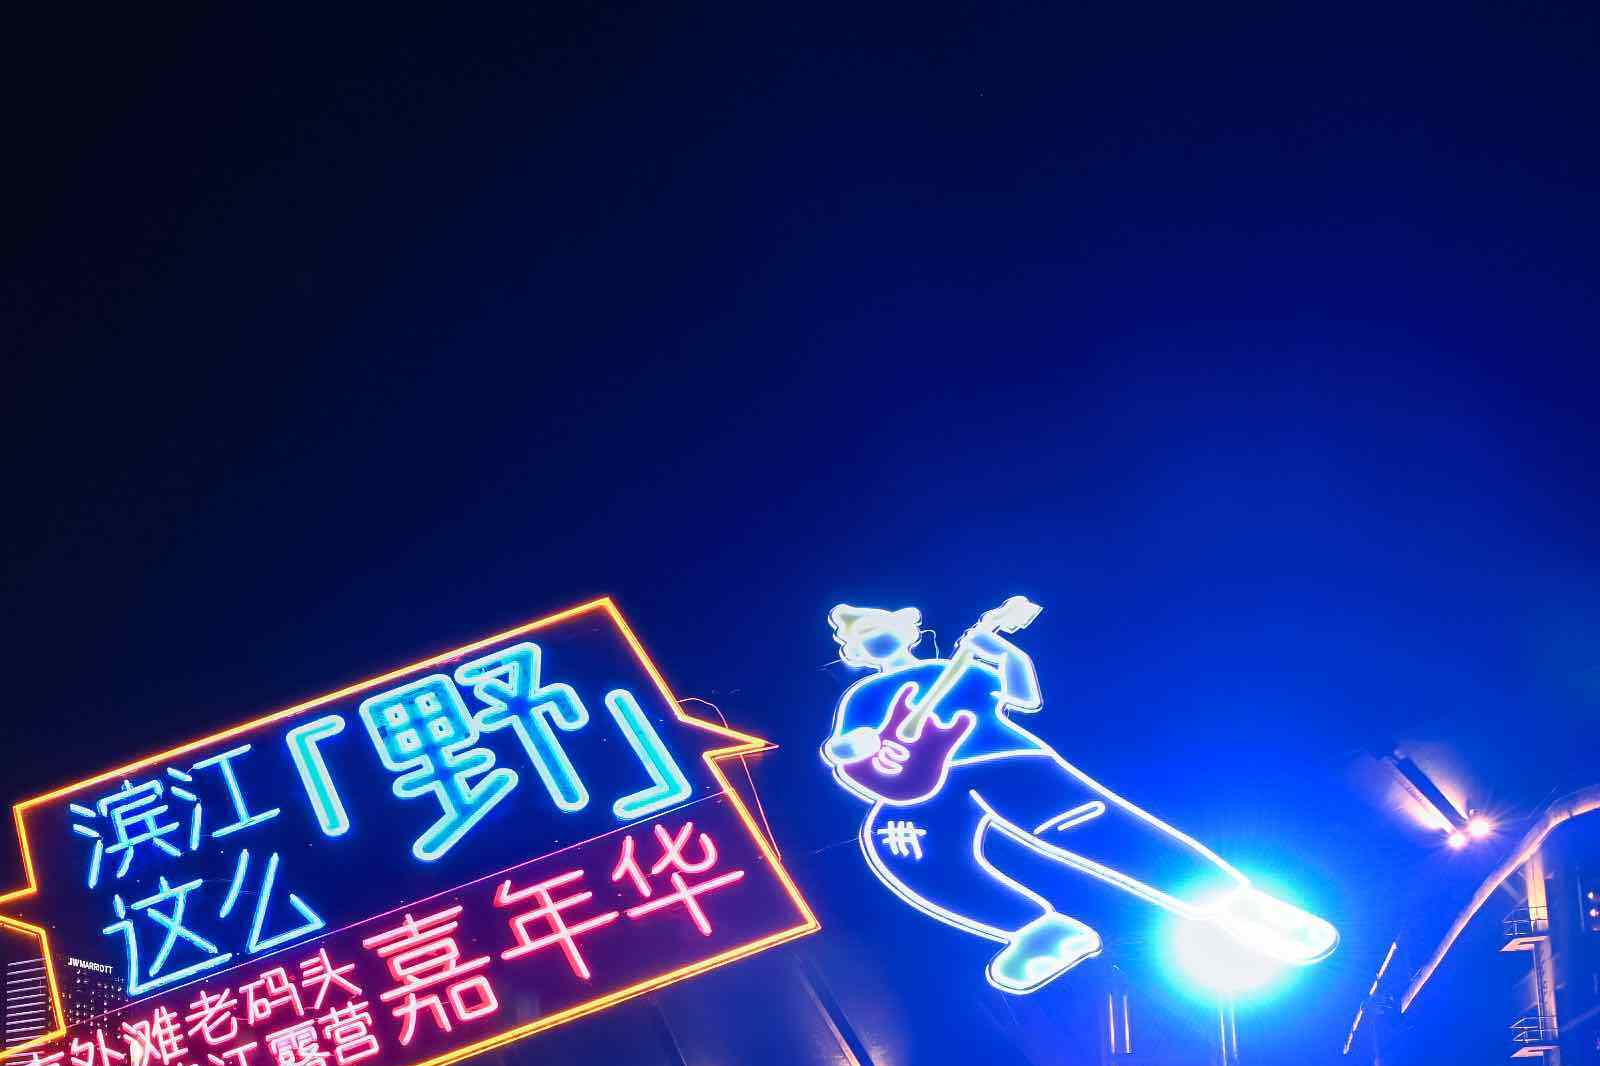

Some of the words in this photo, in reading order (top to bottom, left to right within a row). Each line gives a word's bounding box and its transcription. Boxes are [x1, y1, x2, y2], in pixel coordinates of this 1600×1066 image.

[69, 743, 281, 888] 滨江
[103, 850, 325, 998] 这么
[363, 821, 746, 1047] 嘉年华
